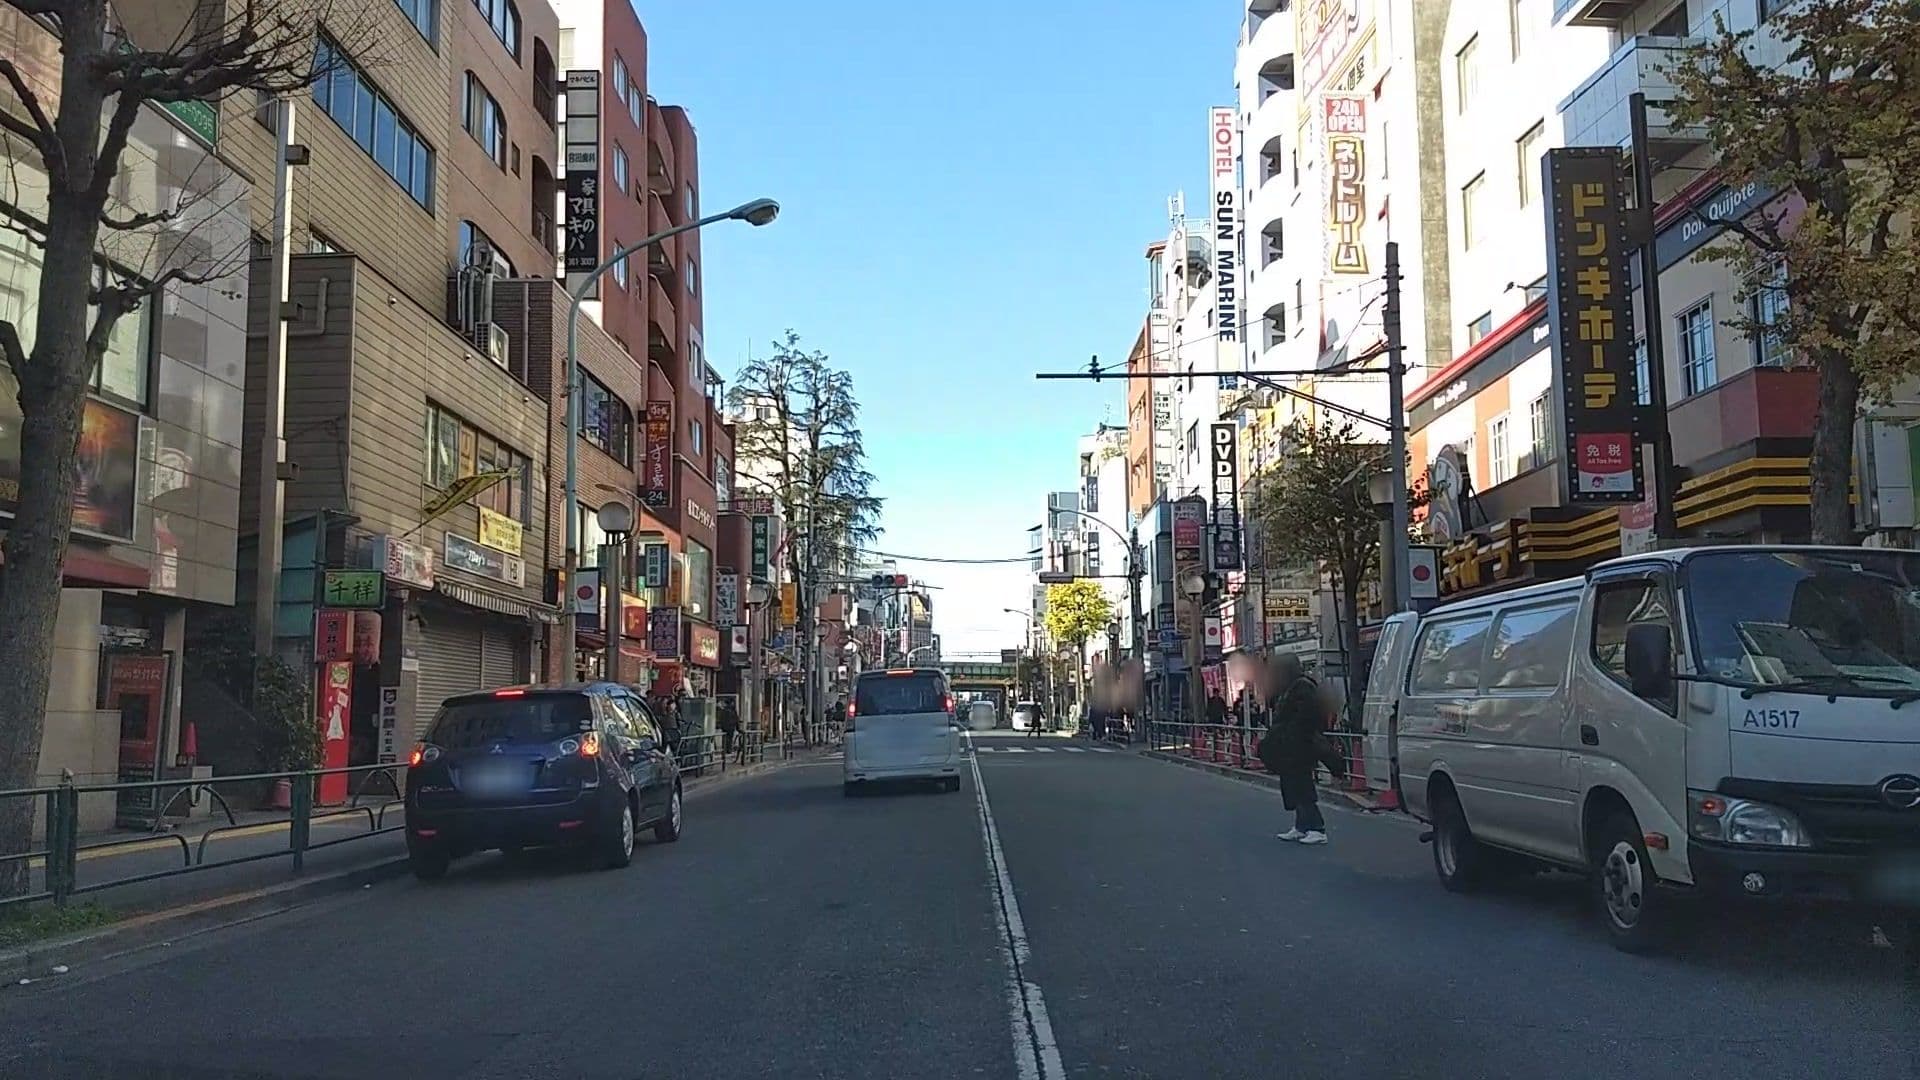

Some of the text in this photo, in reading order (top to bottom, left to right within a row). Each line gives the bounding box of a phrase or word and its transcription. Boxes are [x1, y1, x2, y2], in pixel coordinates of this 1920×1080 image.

[1328, 116, 1364, 131] OPEN
[1331, 100, 1360, 116] 24h
[568, 197, 585, 250] マキバ
[581, 178, 596, 233] 家具の
[1335, 141, 1361, 267] ネットルーム
[1709, 182, 1755, 220] Quijote
[1215, 113, 1236, 341] HOTEL SUN MARINE
[1573, 184, 1616, 408] ドン・キホーテ
[650, 444, 667, 489] すき家
[649, 491, 663, 501] 24
[1743, 709, 1800, 728] A1517
